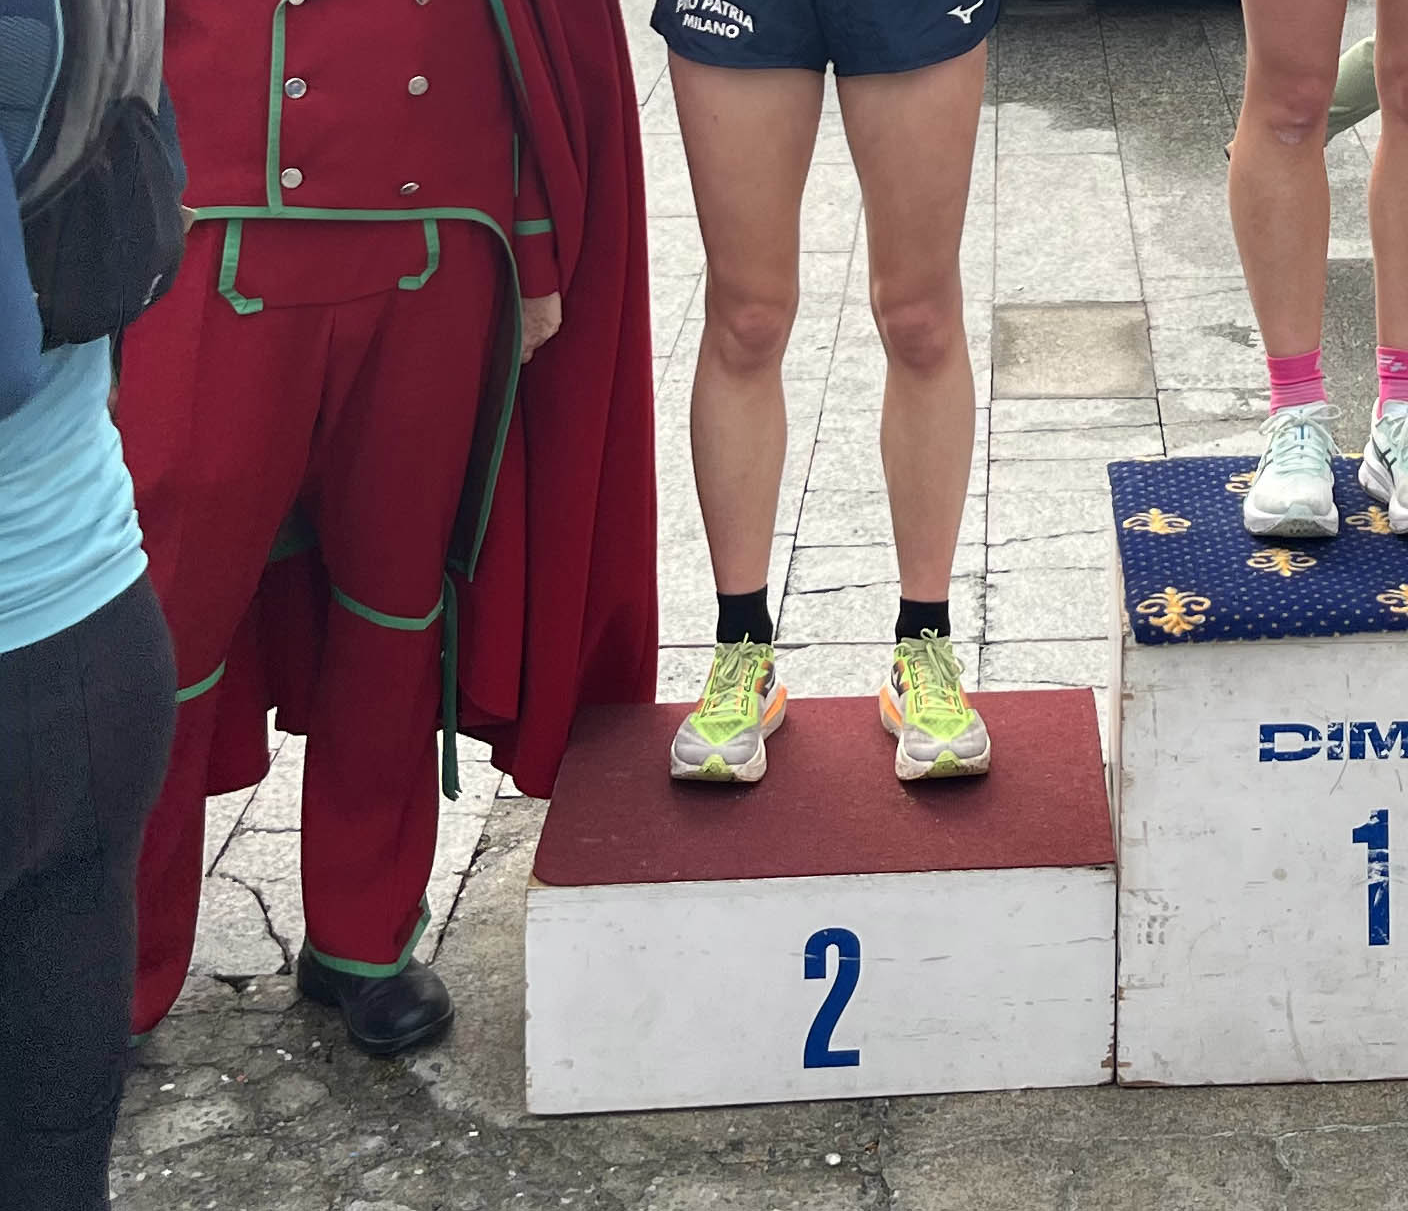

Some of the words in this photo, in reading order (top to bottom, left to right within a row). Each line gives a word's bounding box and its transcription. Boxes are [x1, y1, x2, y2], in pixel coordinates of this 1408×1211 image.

[682, 13, 740, 39] MILANO
[1352, 809, 1391, 947] 1
[803, 927, 861, 1069] 2
